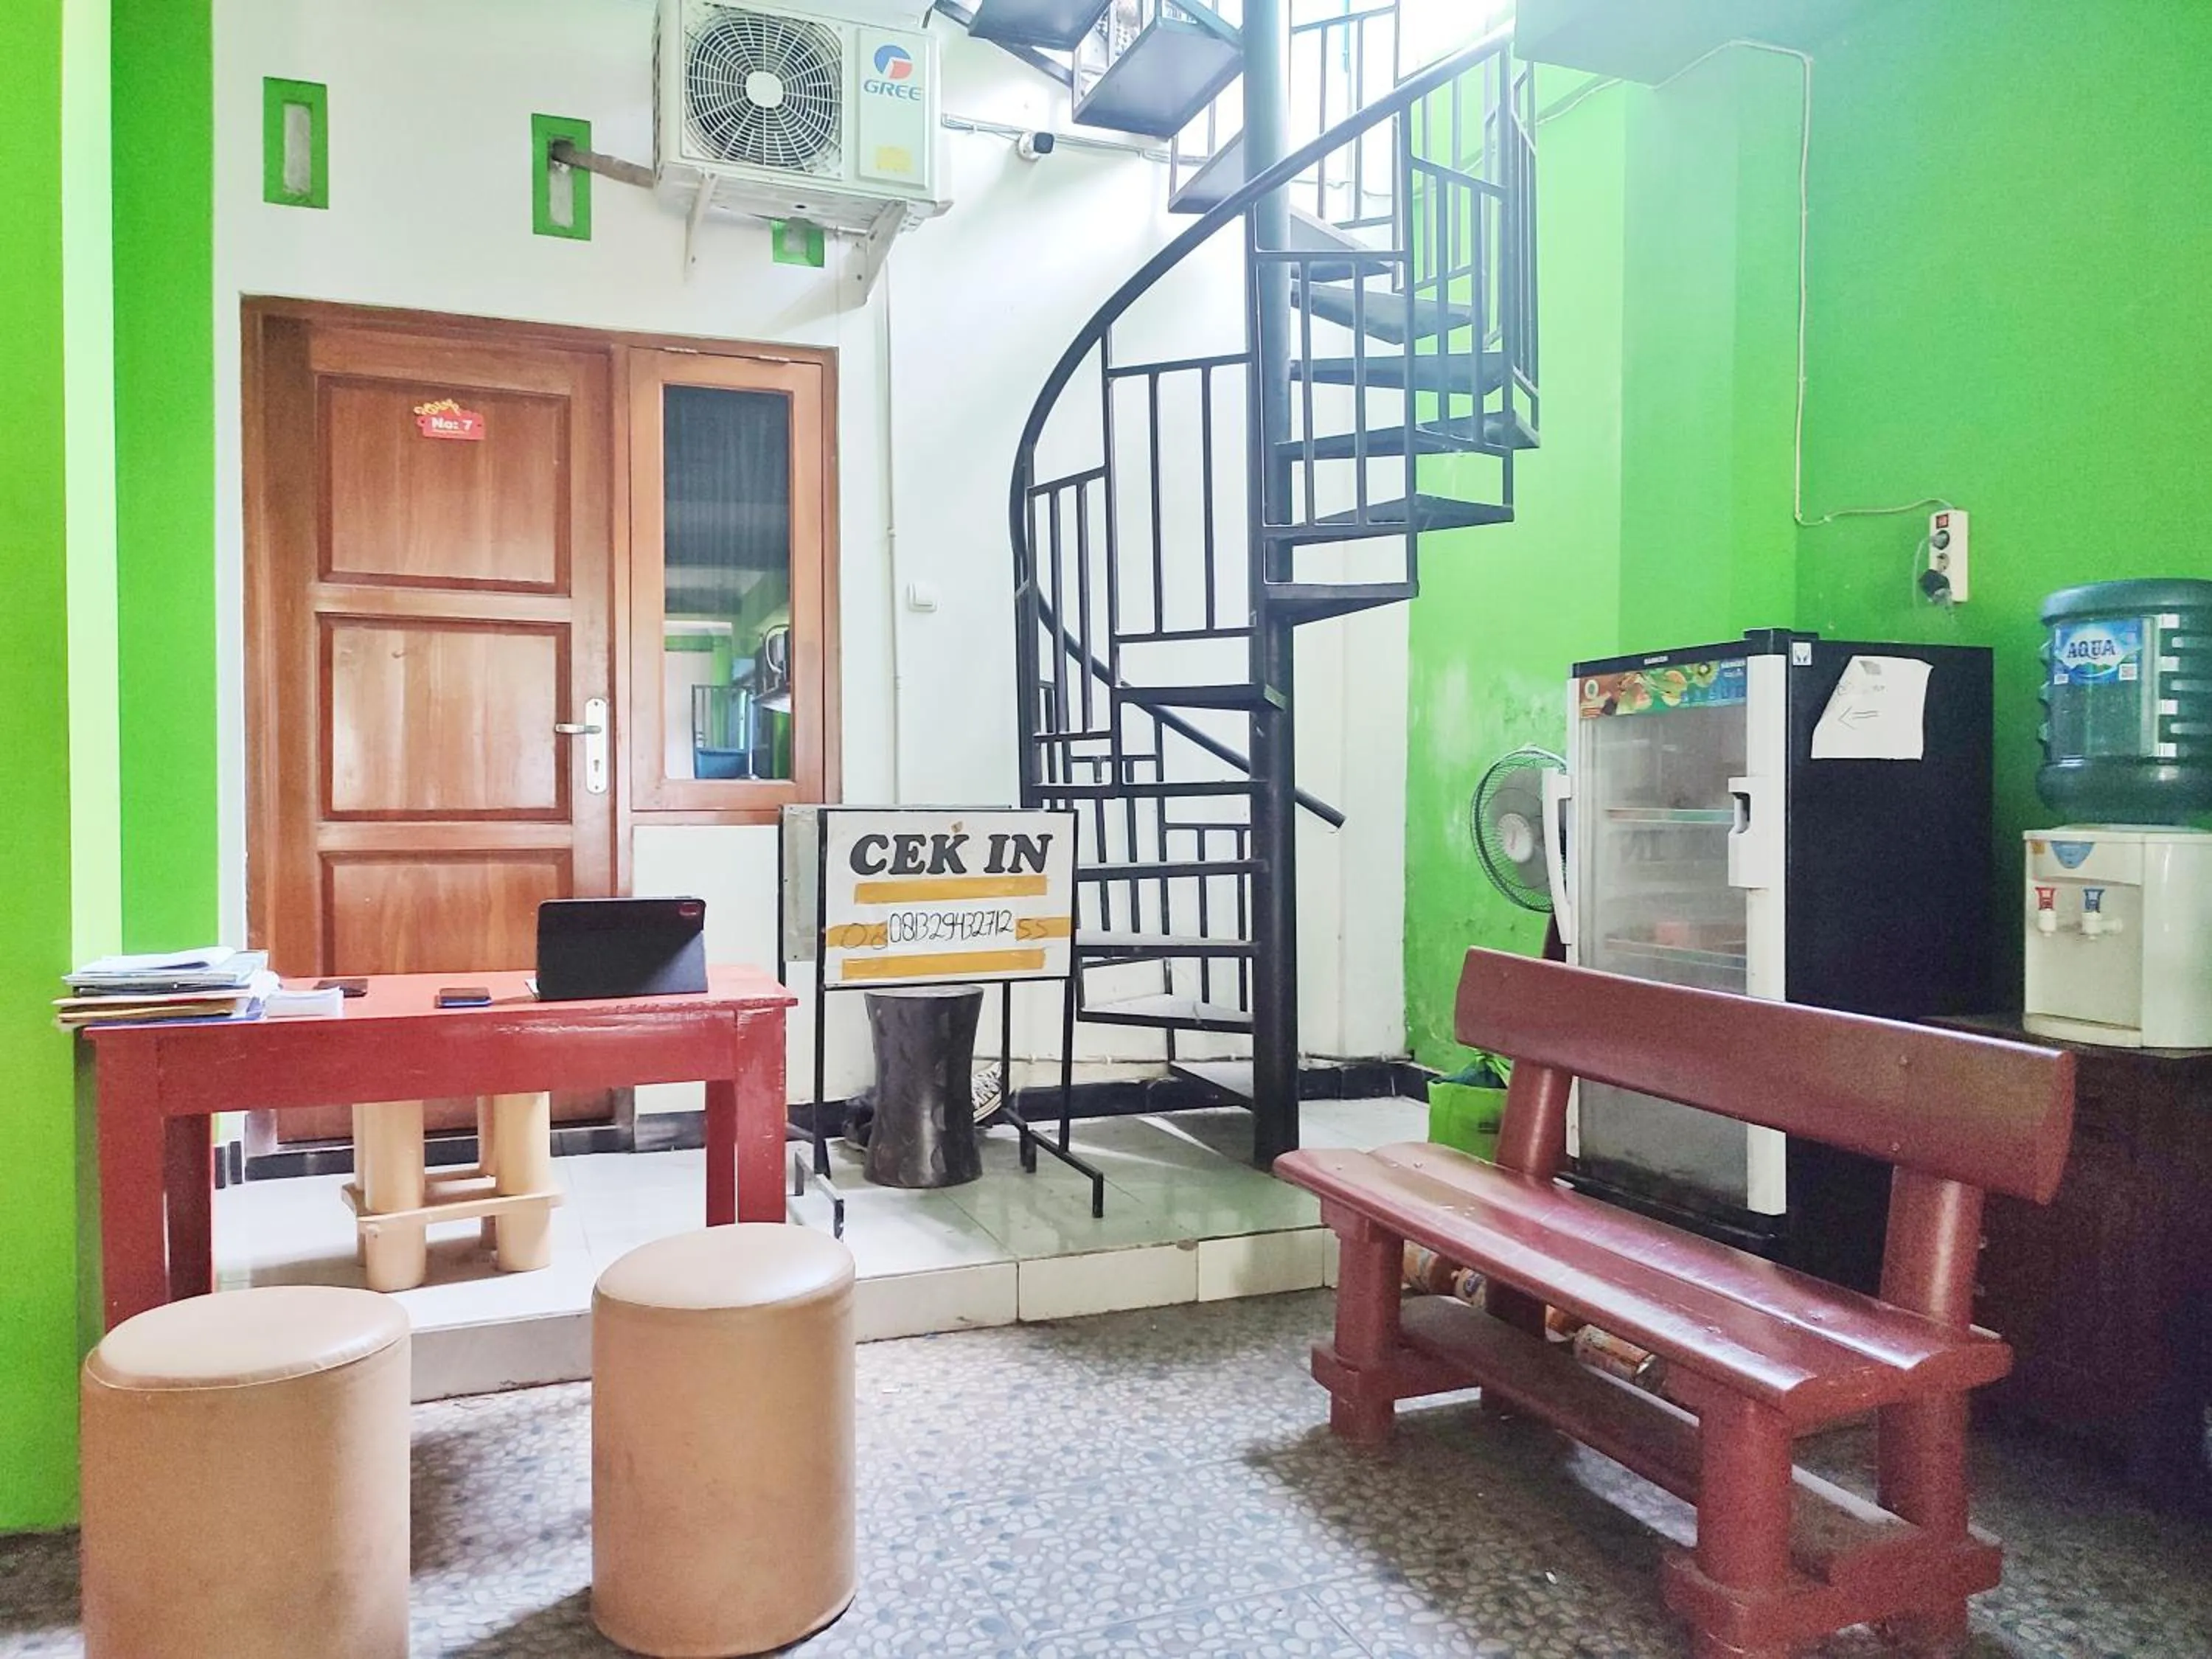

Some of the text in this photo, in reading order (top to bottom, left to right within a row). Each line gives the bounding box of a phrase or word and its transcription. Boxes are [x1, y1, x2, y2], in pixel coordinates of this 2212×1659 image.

[863, 79, 922, 101] GREE
[462, 420, 473, 431] 7
[2067, 639, 2115, 660] AQUA
[850, 834, 1053, 875] CEK IN
